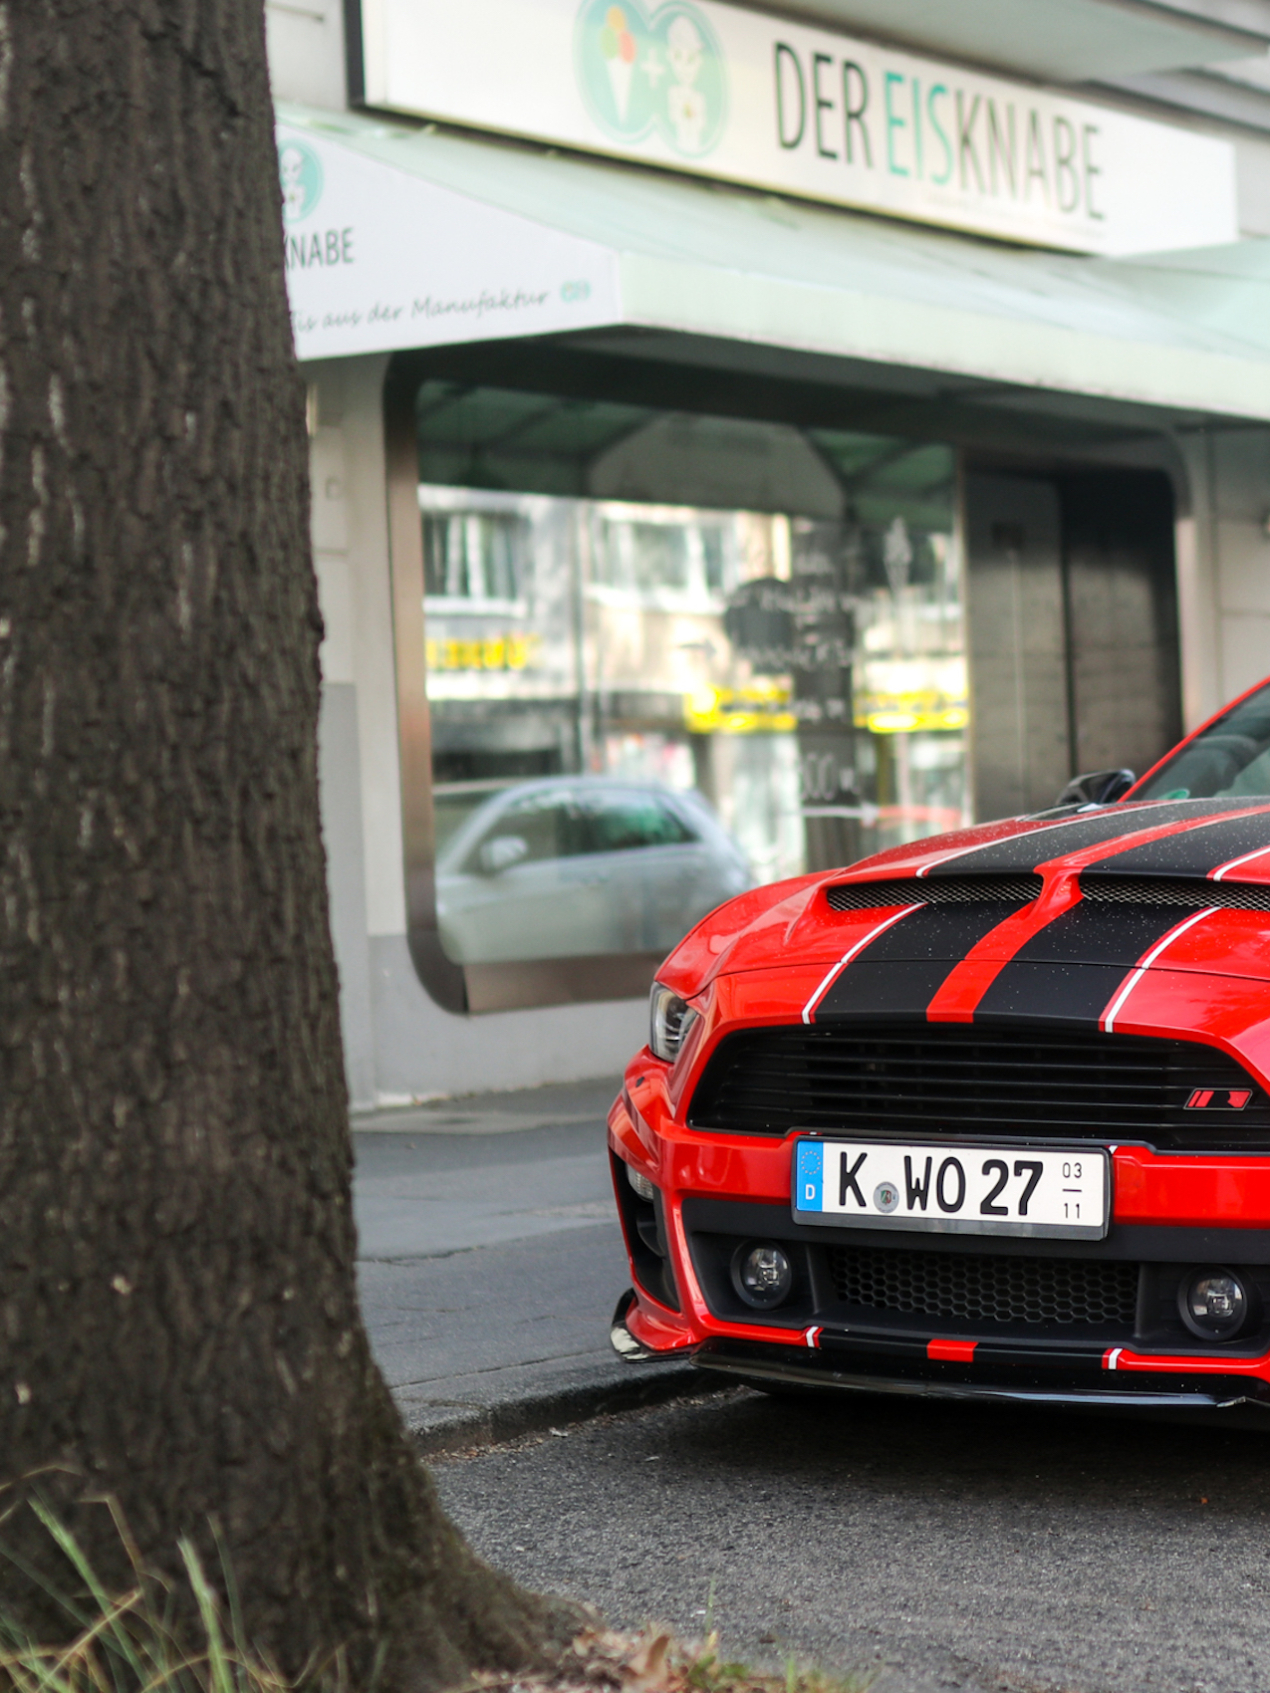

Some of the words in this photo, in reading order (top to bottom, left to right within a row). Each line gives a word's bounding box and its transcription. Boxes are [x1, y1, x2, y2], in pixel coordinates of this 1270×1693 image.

[774, 40, 873, 169] DER
[884, 69, 1105, 221] EISKNABE
[323, 311, 363, 328] aus
[366, 304, 404, 324] der
[410, 289, 550, 322] Manufaktur
[838, 1151, 868, 1207] K
[979, 1159, 1044, 1216] 27
[1062, 1162, 1083, 1179] 03
[805, 1183, 817, 1201] D
[1063, 1202, 1081, 1219] 11
